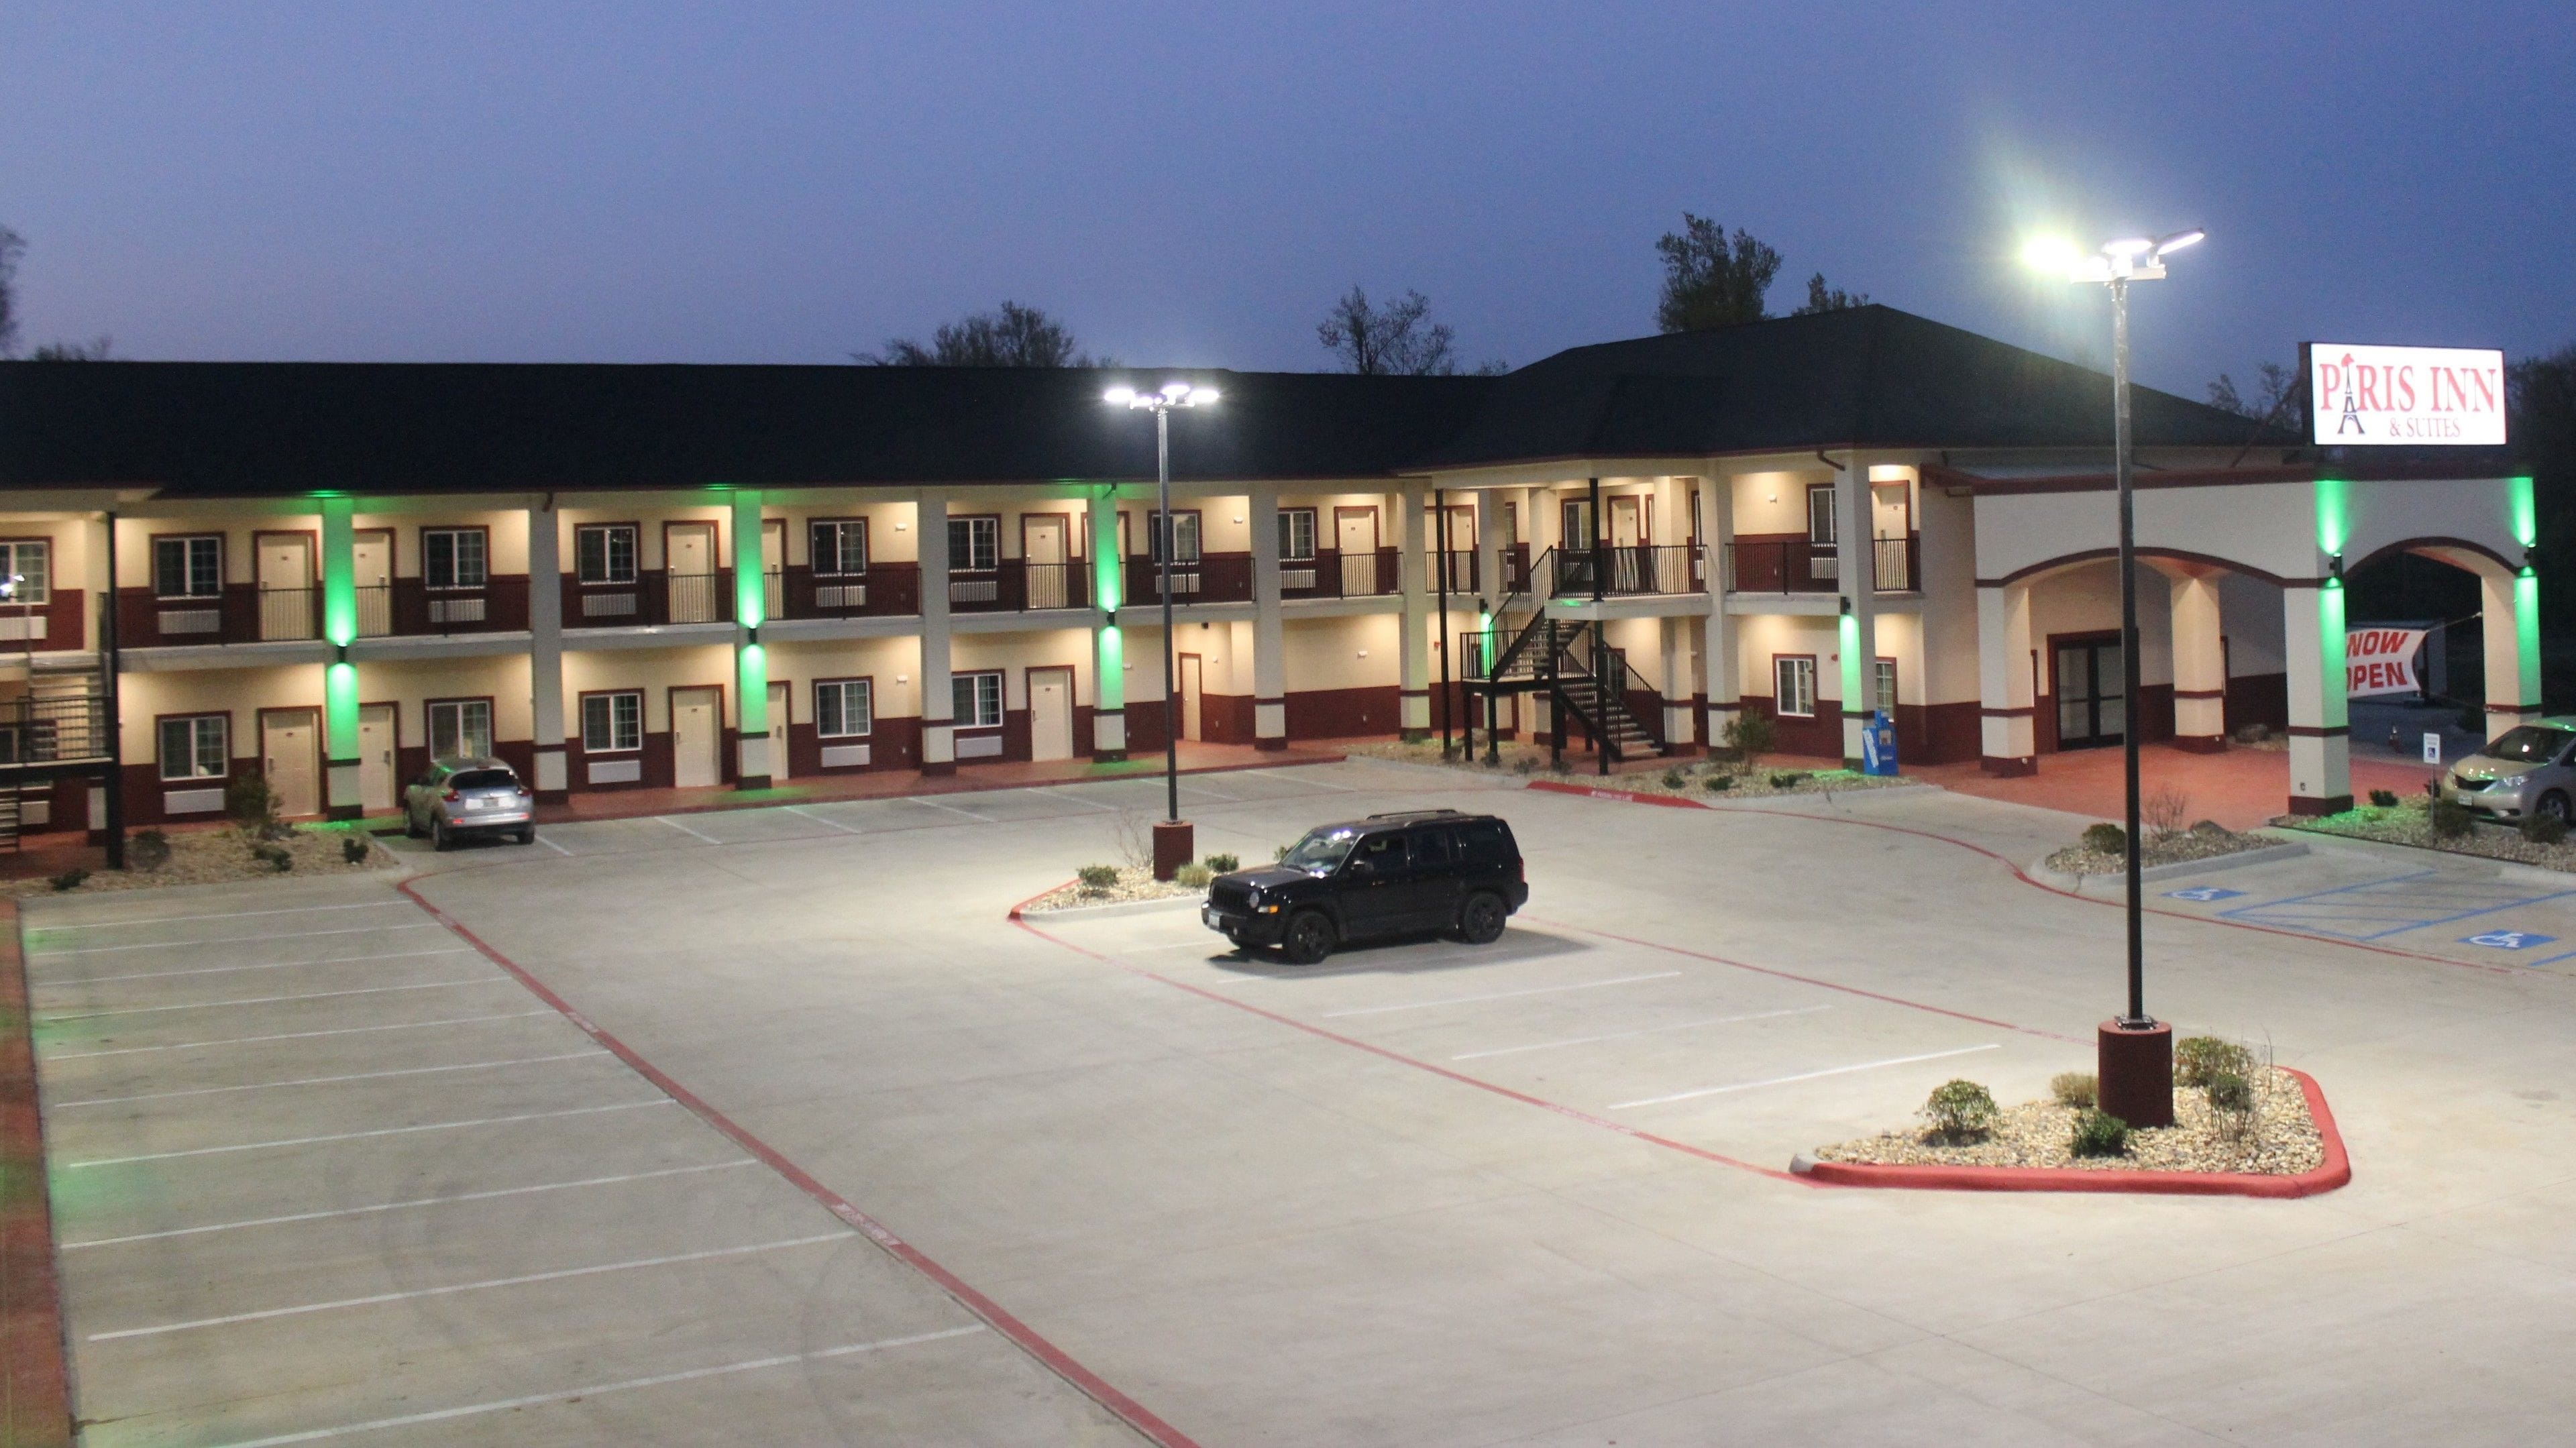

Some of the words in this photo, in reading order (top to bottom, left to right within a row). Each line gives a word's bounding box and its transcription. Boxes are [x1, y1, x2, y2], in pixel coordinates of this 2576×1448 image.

[2319, 362, 2415, 435] PARIS
[2430, 367, 2496, 413] INN
[2390, 417, 2402, 437] &
[2407, 417, 2461, 437] SUITES
[2347, 631, 2409, 657] NOW
